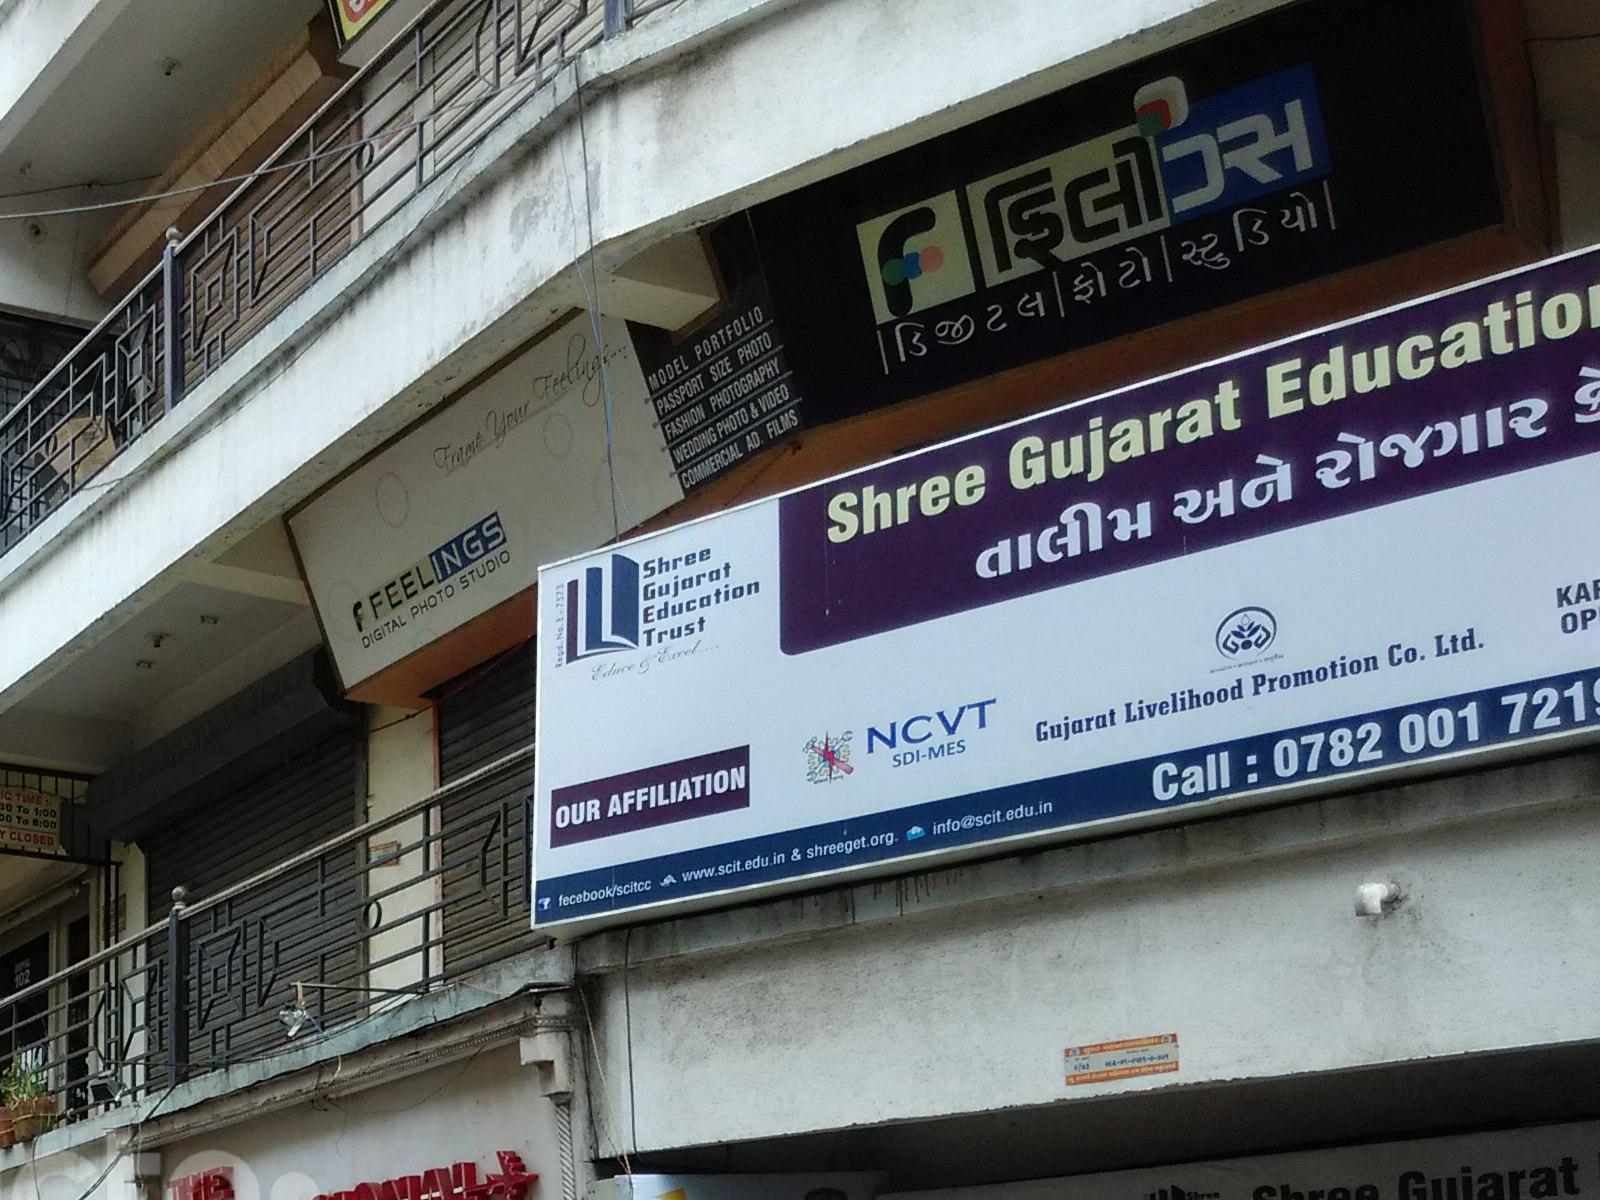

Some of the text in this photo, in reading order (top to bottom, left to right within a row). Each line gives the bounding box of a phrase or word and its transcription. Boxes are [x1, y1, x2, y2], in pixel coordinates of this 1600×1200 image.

[648, 305, 763, 391] MODEL PORTFOLIO
[656, 332, 772, 416] PASSPORT SIZE PHOTO
[664, 356, 781, 441] FASHION PHOTOGRAPHY
[673, 384, 790, 464] WEDDING PHOTO & VIDEO
[433, 401, 530, 476] Frame Your
[681, 442, 743, 489] COMMERCIAL
[766, 409, 798, 439] FILMS
[827, 465, 986, 543] Shree
[1009, 381, 1241, 490] Gujarat
[975, 397, 1548, 578] તાલીમ અને રોજગાર
[362, 550, 511, 648] DIGITAL PHOTO STUDIO
[369, 515, 507, 619] FEELINGS
[642, 548, 711, 579] Shree
[642, 562, 732, 601] Gujarat
[642, 580, 761, 624] Education
[643, 617, 706, 647] Trust
[1035, 708, 1117, 742] Gujarat
[1124, 679, 1243, 723] Livelihood
[1252, 652, 1379, 697] Promotion
[1387, 643, 1426, 668] Co.
[1434, 628, 1484, 658] Ltd.
[866, 698, 997, 754] NCVT
[892, 739, 966, 768] SDI-MES
[1152, 751, 1231, 801] Call
[1273, 722, 1383, 778] 0782
[1399, 702, 1480, 754] 001
[15, 793, 43, 805] TIME
[16, 805, 30, 815] To
[16, 816, 29, 826] To
[555, 765, 746, 829] OUR AFFILIATION
[9, 831, 54, 845] CLOSED
[558, 879, 652, 907] fecebook/scitcc
[682, 853, 785, 882] www.scit.edu.in
[791, 849, 802, 862] &
[933, 800, 1053, 835] info@scit.edu.in
